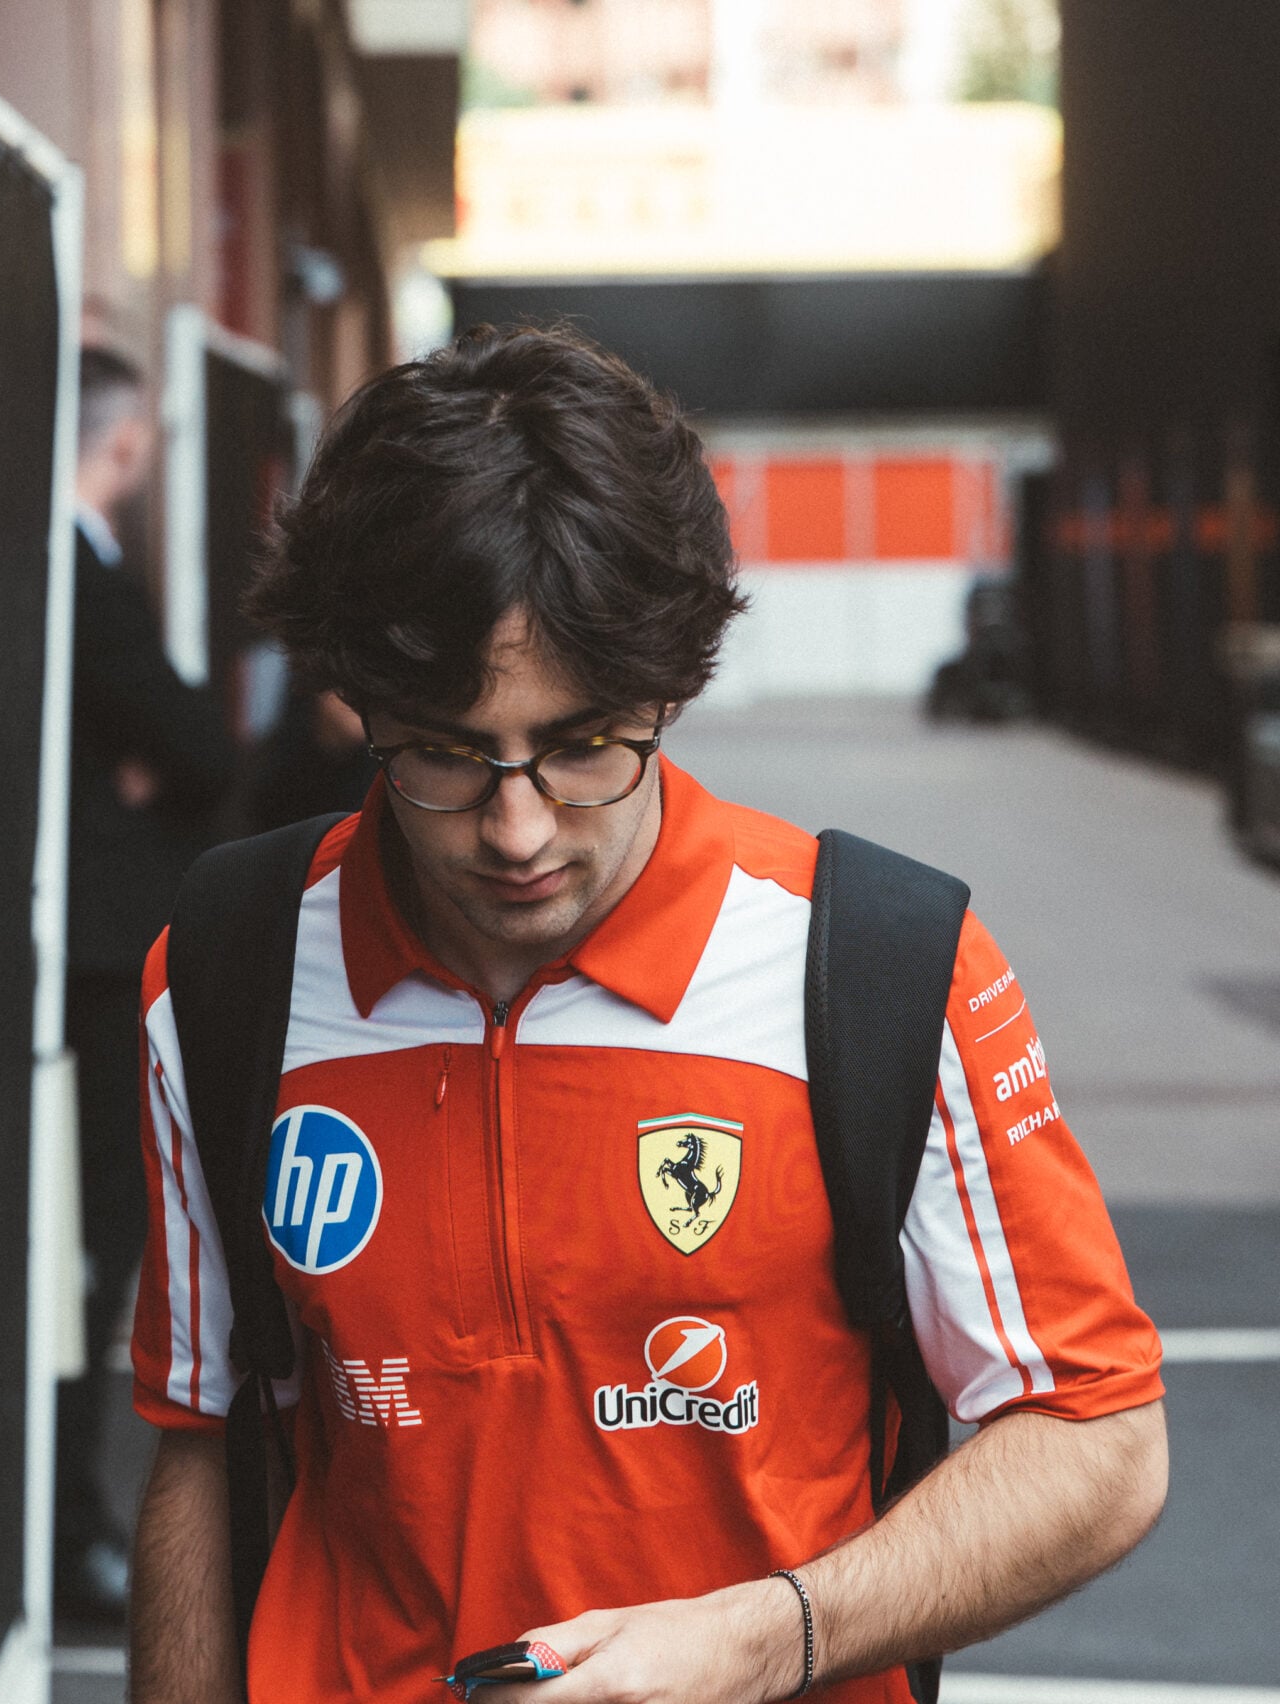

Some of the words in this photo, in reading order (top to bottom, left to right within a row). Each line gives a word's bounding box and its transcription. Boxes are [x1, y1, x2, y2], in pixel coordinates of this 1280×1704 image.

[272, 1111, 363, 1269] hp
[321, 1338, 423, 1427] BM
[597, 1386, 758, 1431] UniCredit
